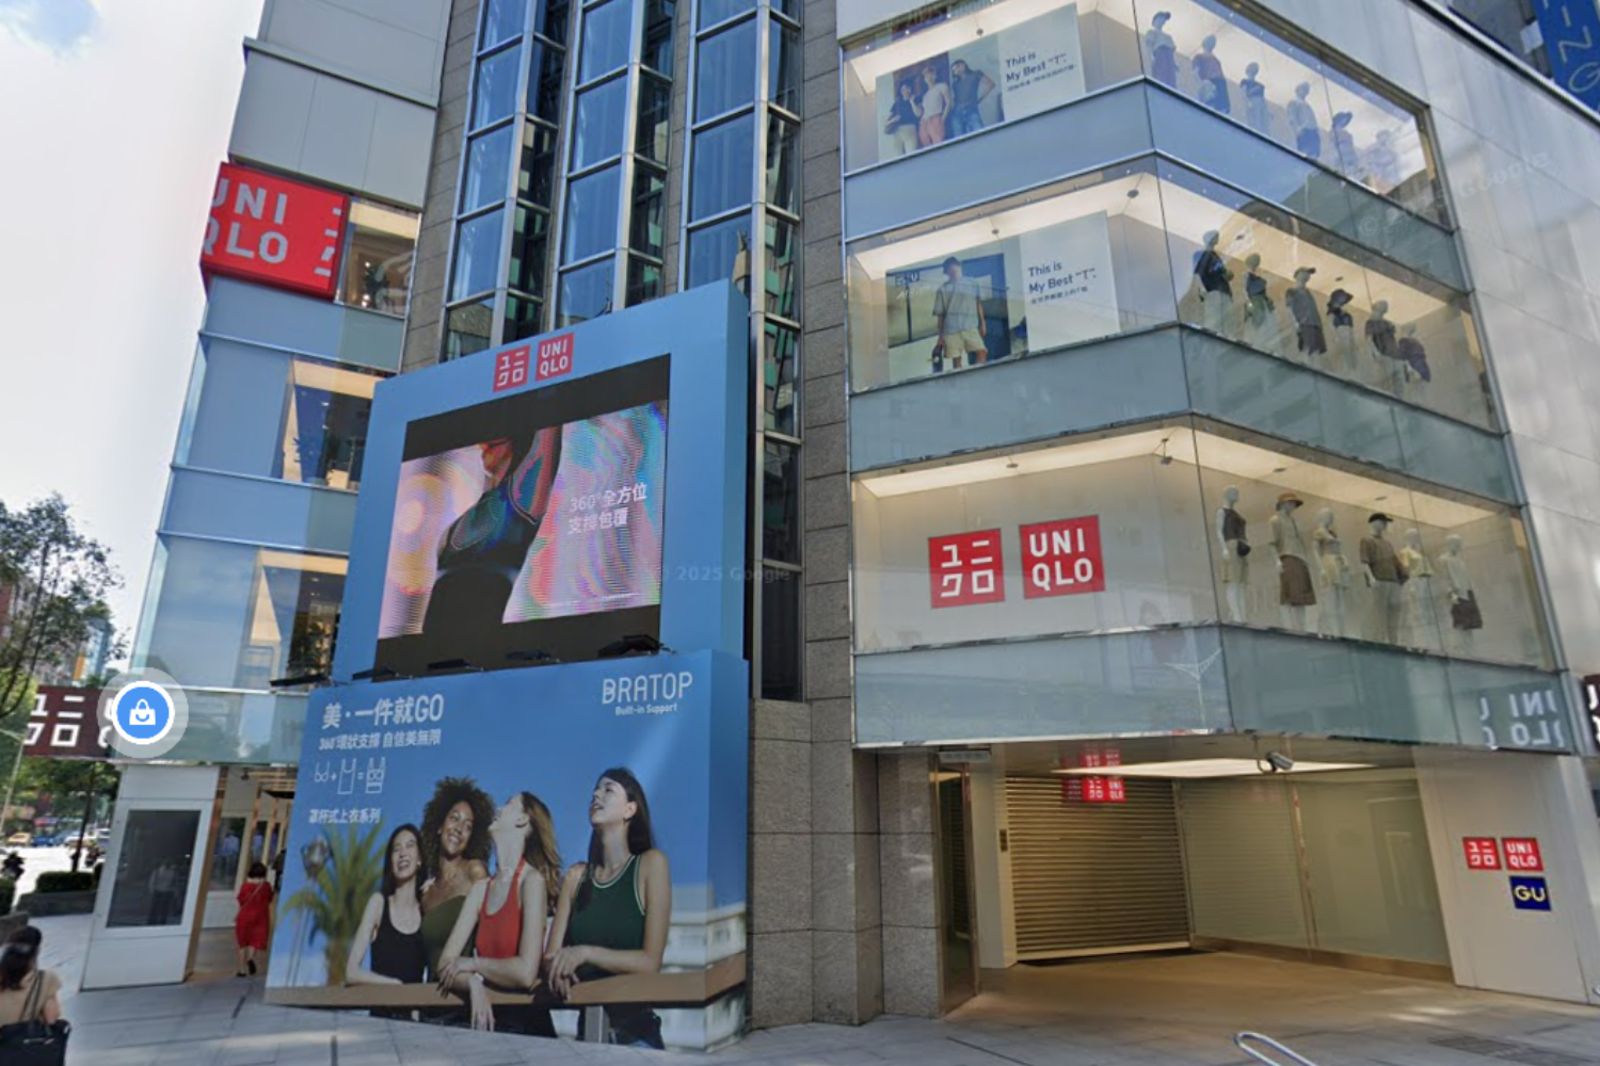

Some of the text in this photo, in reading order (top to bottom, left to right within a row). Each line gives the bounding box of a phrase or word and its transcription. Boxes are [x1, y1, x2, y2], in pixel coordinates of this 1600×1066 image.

[1028, 259, 1063, 278] This is
[1028, 281, 1046, 294] My
[1047, 273, 1074, 289] Best
[541, 338, 569, 359] UNI
[499, 350, 526, 371] ユニ
[540, 355, 569, 377] QLO
[1029, 527, 1086, 558] UNI
[941, 539, 993, 569] ユニ
[940, 568, 995, 598] クロ
[1032, 557, 1093, 592] QLO
[602, 671, 693, 705] BRATOP
[646, 702, 678, 715] Support
[1506, 841, 1533, 854] UNI
[1509, 855, 1538, 869] QLO
[1514, 884, 1546, 903] GU
